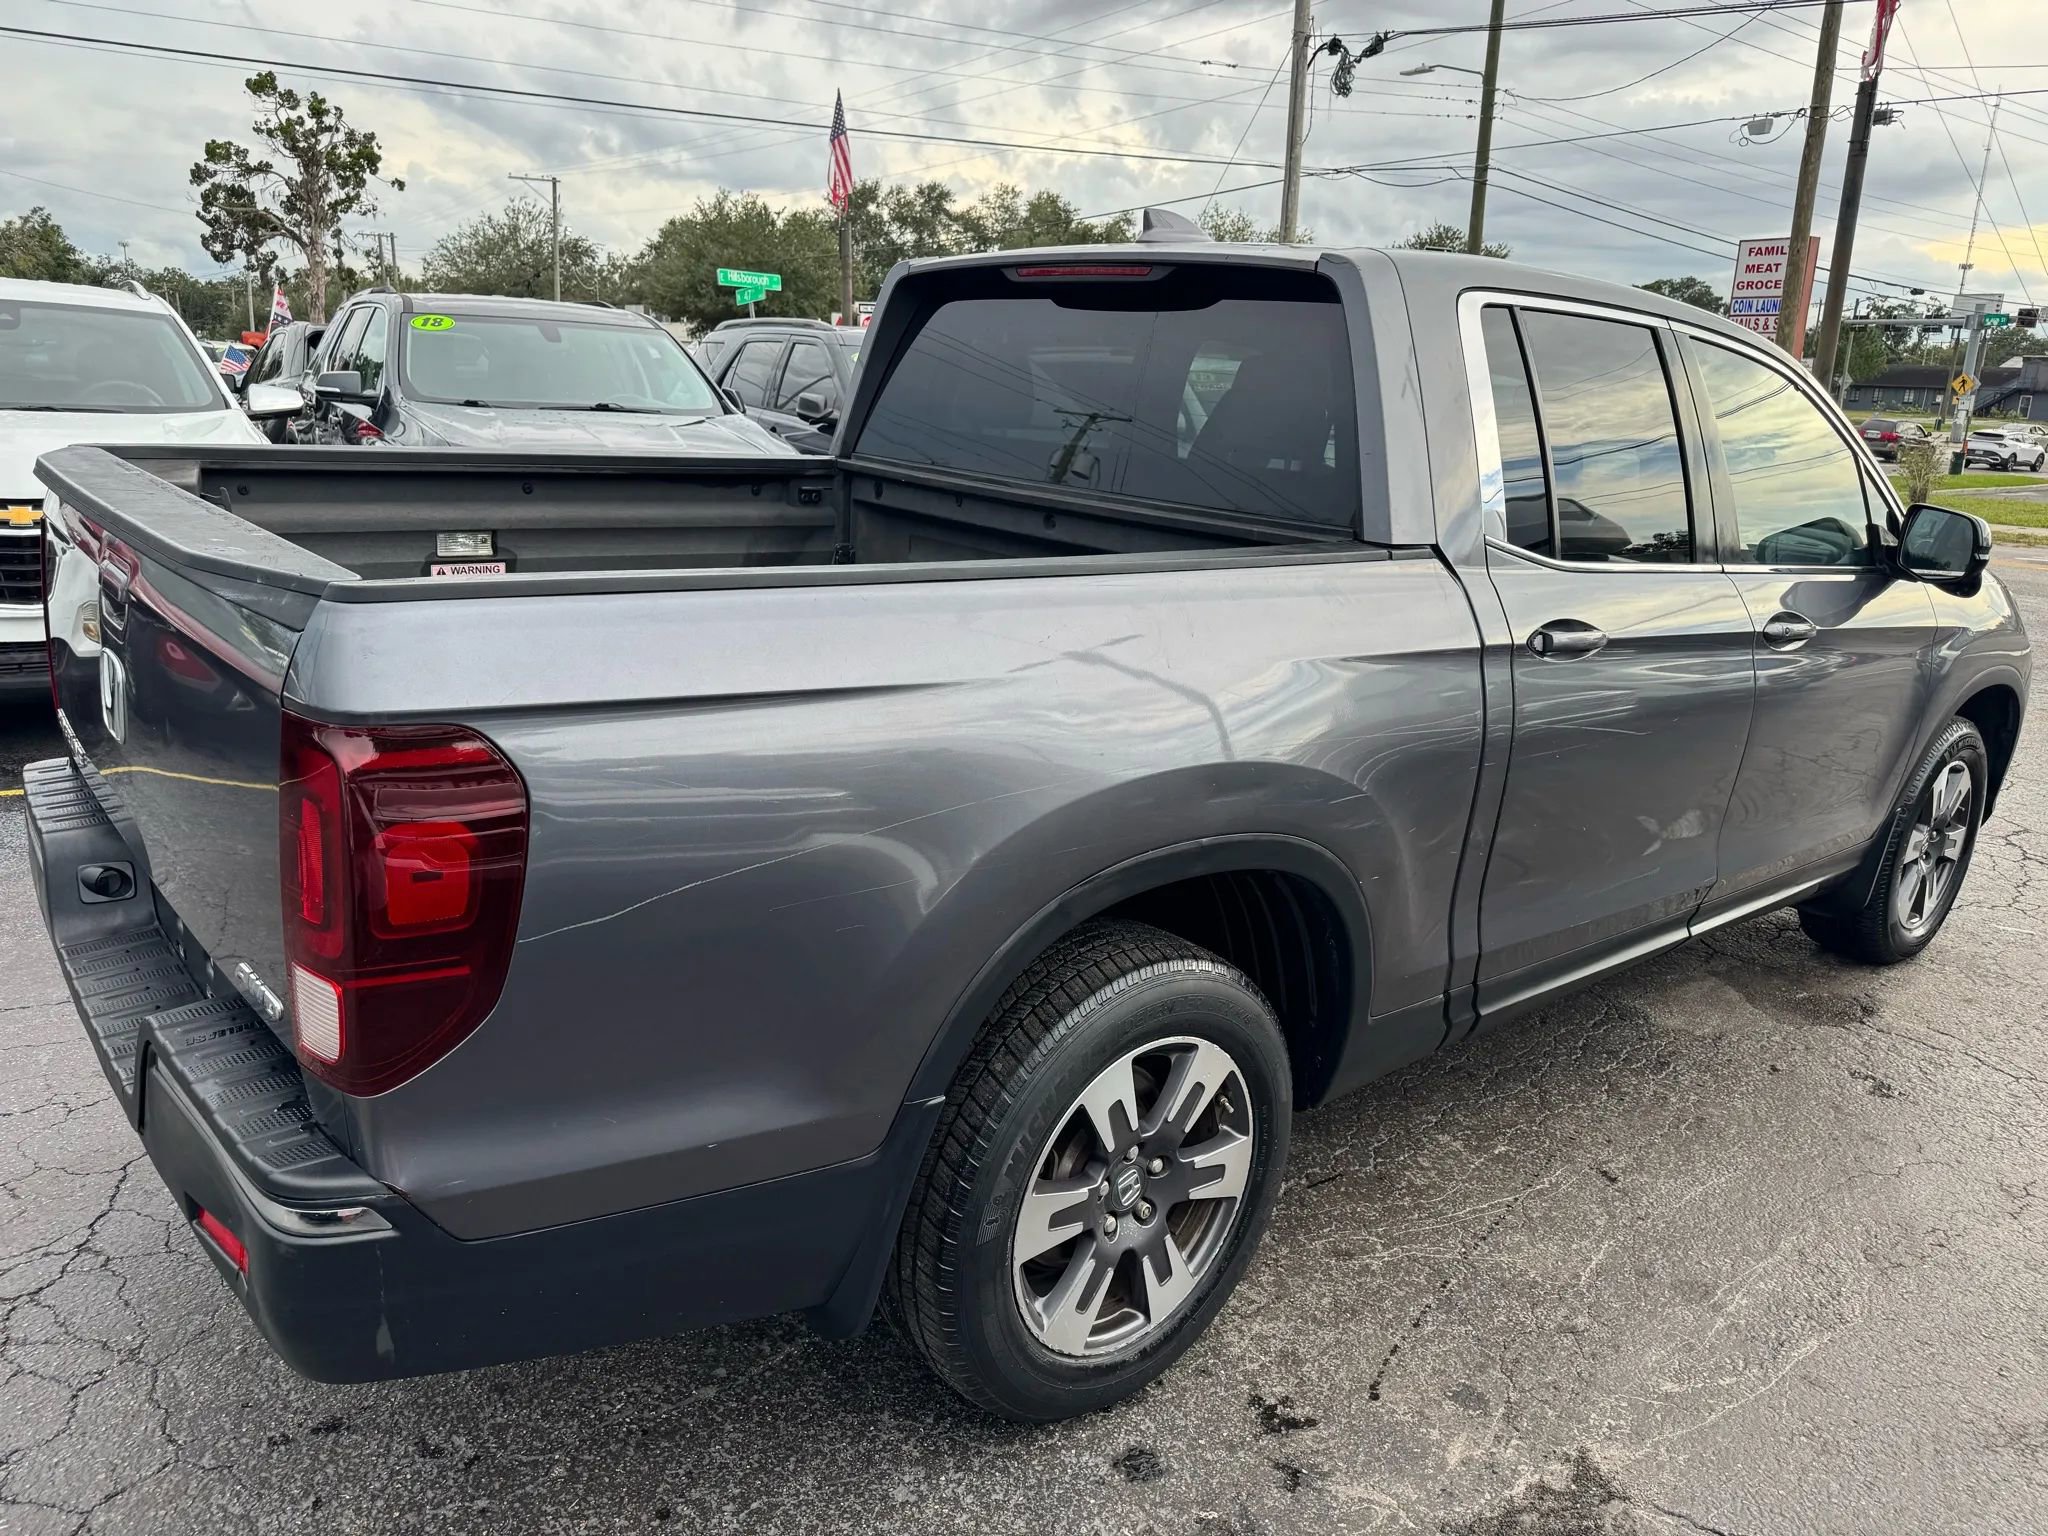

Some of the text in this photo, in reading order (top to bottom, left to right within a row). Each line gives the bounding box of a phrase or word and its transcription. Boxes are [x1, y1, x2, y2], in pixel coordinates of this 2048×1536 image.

[1748, 246, 1788, 257] FAMIL
[1745, 263, 1782, 274] MEAT
[728, 270, 770, 286] Hillsborough
[1736, 280, 1782, 291] GROCE
[1733, 299, 1753, 314] COIN
[421, 317, 444, 327] 18
[450, 565, 501, 575] WARNING
